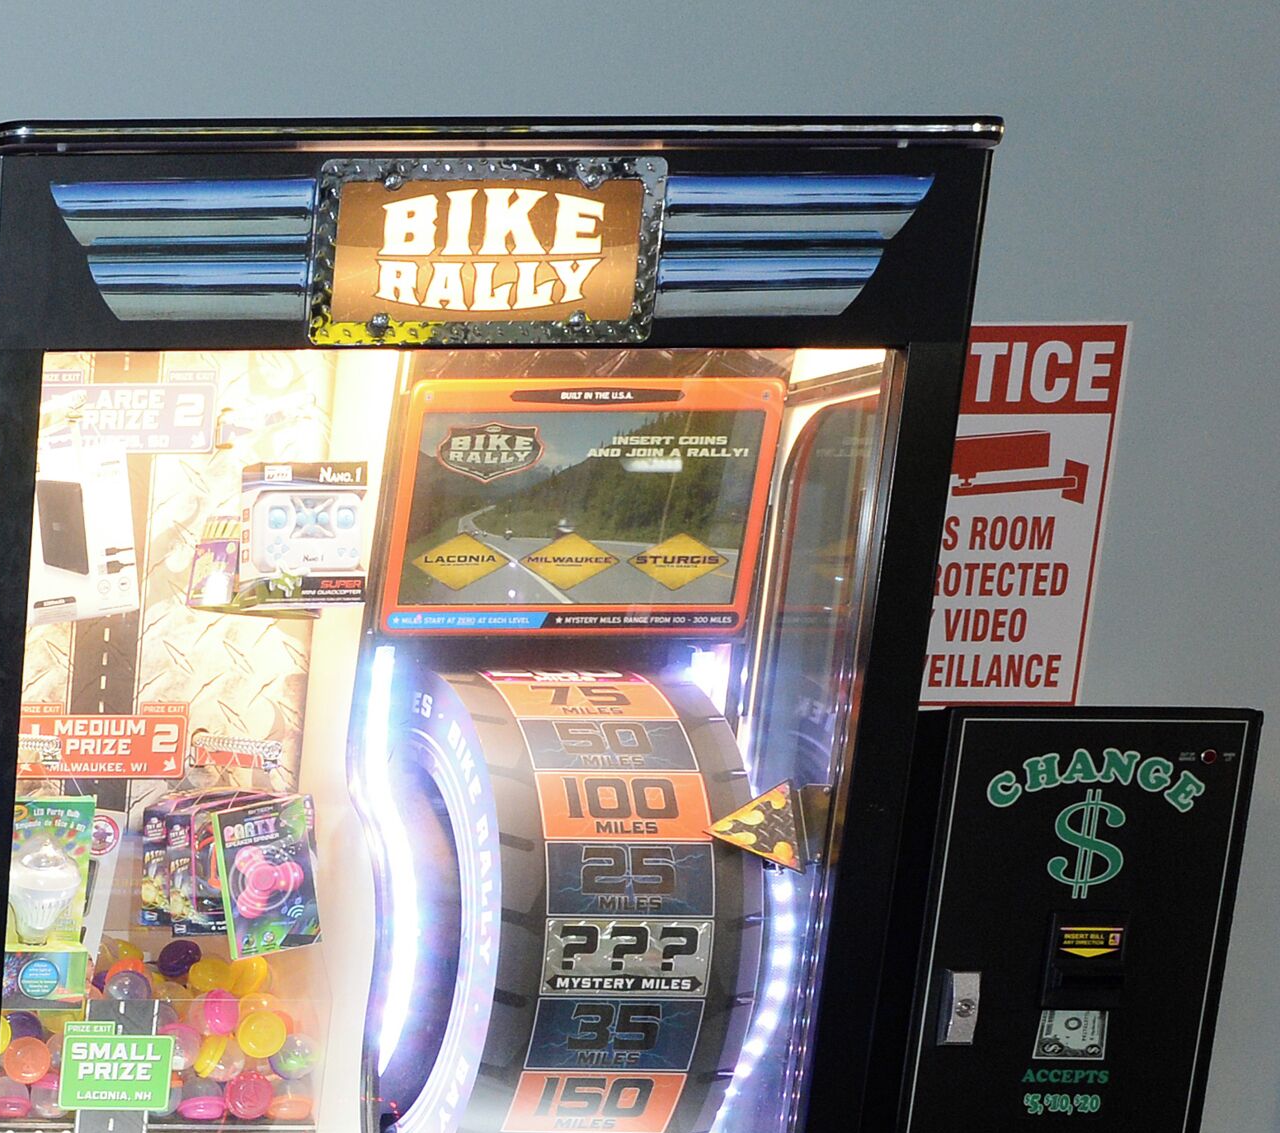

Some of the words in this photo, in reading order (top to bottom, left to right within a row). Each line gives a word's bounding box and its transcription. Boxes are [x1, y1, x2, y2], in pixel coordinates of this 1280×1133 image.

[377, 188, 605, 256] BIKE
[373, 257, 605, 311] RALLY
[970, 340, 1115, 403] TICE
[561, 392, 582, 400] BUILT
[173, 393, 205, 427] 2
[450, 435, 534, 450] BIKE
[612, 436, 674, 445] INSERT
[678, 436, 728, 445] COINS
[449, 451, 530, 464] RALLY
[587, 448, 621, 457] AND
[625, 448, 667, 457] JOIN
[670, 448, 682, 457] A
[686, 448, 749, 457] RALLY!
[969, 516, 1055, 551] ROOM
[424, 555, 496, 563] LACONIA
[527, 556, 613, 564] MILWAUKEE
[636, 555, 719, 565] STURGIS
[320, 580, 361, 588] SUPER
[934, 562, 1069, 597] ROTECTED
[424, 616, 445, 624] START
[447, 616, 456, 624] AT
[457, 616, 475, 625] ZERO
[478, 616, 487, 624] AT
[509, 616, 530, 624] LEVEL
[944, 608, 1027, 642] VIDEO
[925, 654, 1061, 688] EILLANCE
[528, 685, 631, 706] 75
[561, 705, 624, 715] MILES
[54, 719, 146, 736] MEDIUM
[151, 723, 179, 753] 2
[553, 721, 653, 754] 50
[65, 738, 132, 755] PRIZE
[130, 763, 148, 772] WI
[581, 754, 645, 767] MILES
[987, 748, 1205, 813] CHANGE
[561, 777, 679, 819] 100
[223, 817, 278, 842] PARTY
[595, 821, 658, 834] MILES
[580, 846, 677, 895] 25
[597, 896, 662, 911] MILES
[556, 976, 634, 990] MYSTERY
[641, 977, 692, 990] MILES
[566, 1002, 663, 1052] 35
[71, 1043, 162, 1061] SMALL
[575, 1050, 640, 1066] MILES
[78, 1062, 153, 1080] PRIZE
[1021, 1068, 1109, 1084] ACCEPTS
[76, 1091, 131, 1101] LACONIA,
[135, 1091, 151, 1101] NH
[534, 1076, 656, 1118] 150
[553, 1117, 618, 1130] MILES
